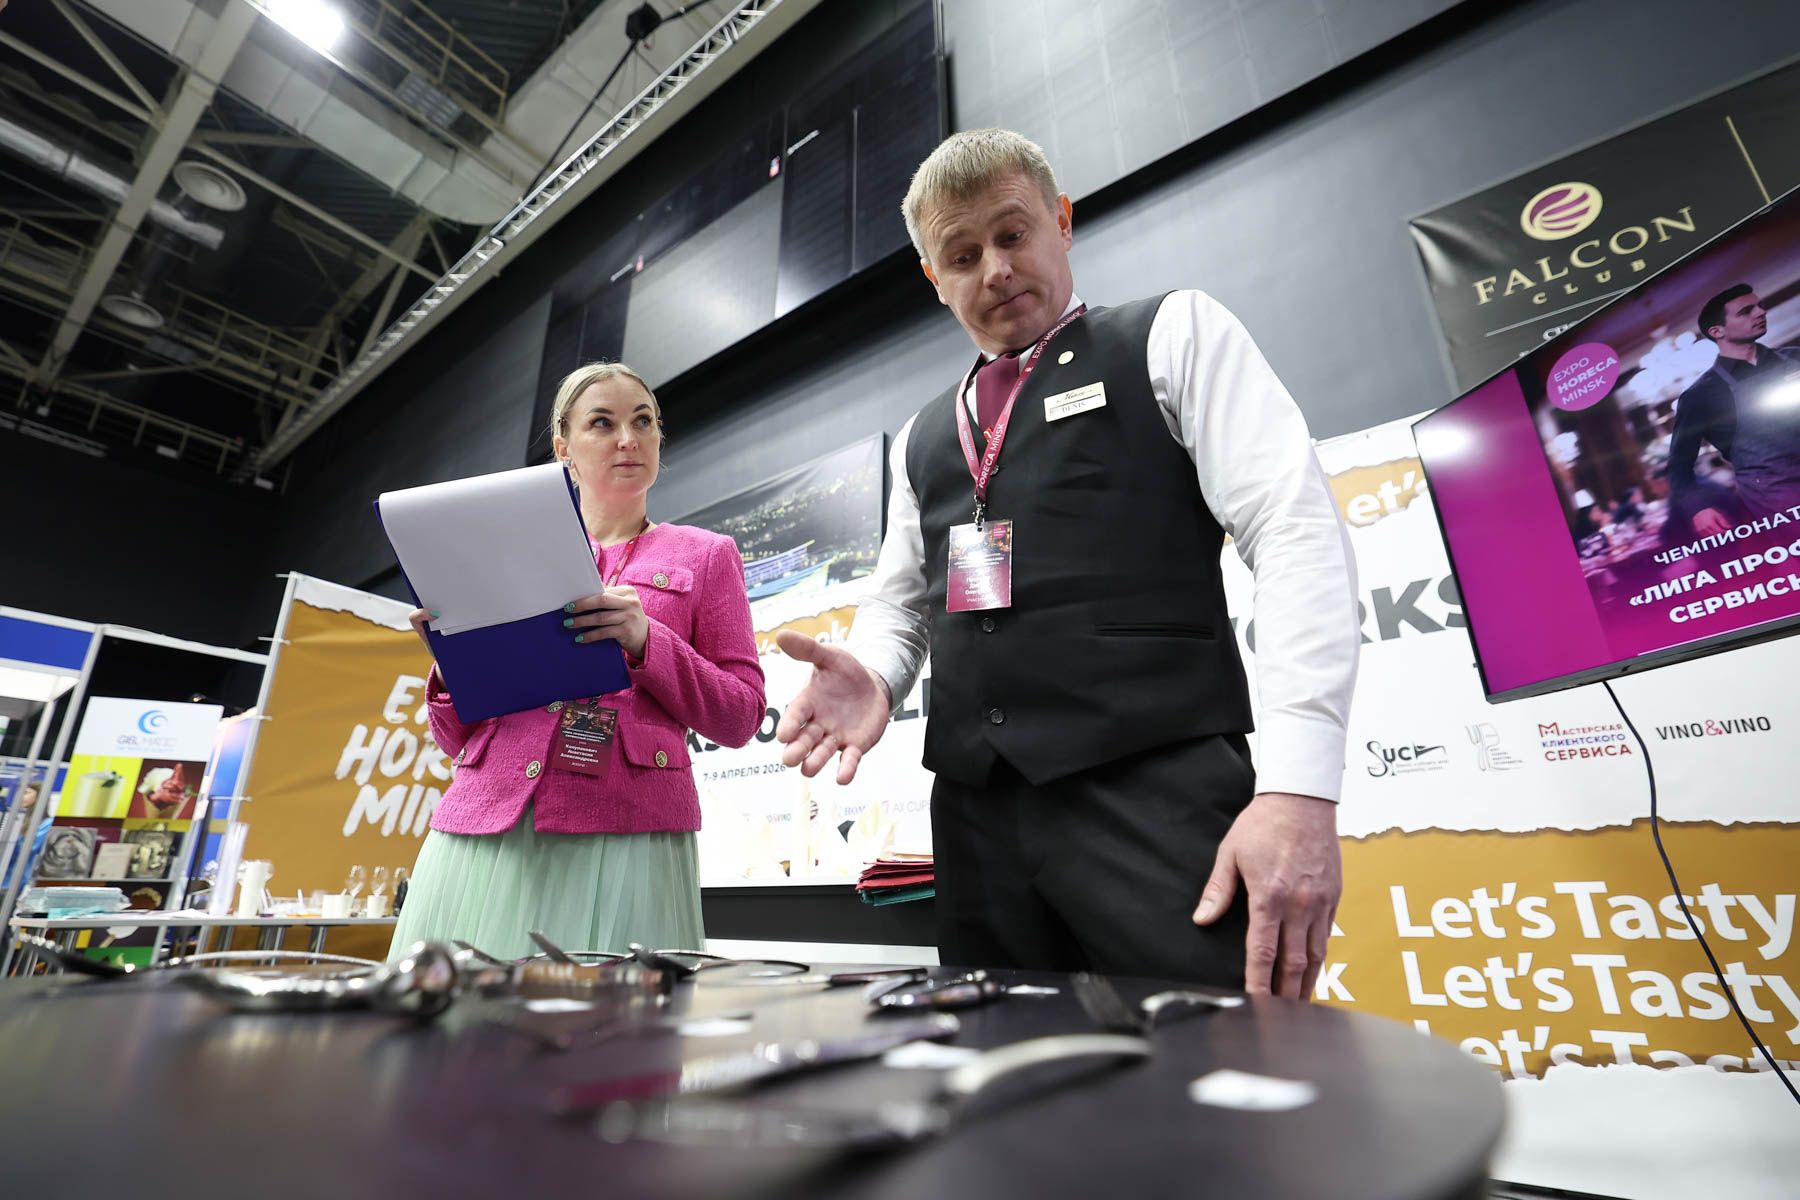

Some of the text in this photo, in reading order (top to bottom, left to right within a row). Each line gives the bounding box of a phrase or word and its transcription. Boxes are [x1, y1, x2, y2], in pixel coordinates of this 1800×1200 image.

[1472, 205, 1697, 305] FALCON
[1532, 259, 1646, 304] CLUB
[1554, 357, 1590, 382] EXPO
[1557, 357, 1617, 393] HORECA
[1561, 375, 1607, 405] MINSK
[990, 423, 1005, 450] MINSK
[1346, 470, 1428, 527] et'
[1653, 505, 1800, 564] ЧЕМПИОНАТ
[1629, 570, 1717, 606] «ЛИГА
[1542, 733, 1626, 748] КЛИЕНТСКОГО
[1656, 716, 1771, 740] VINO&VINO
[334, 723, 456, 786] HOR
[1544, 744, 1632, 762] СЕРВИСА
[720, 766, 760, 780] АПРЕЛЯ
[763, 763, 786, 775] 2026
[1390, 880, 1796, 960] Let's Tasty
[1401, 951, 1574, 1013] Let's
[1571, 953, 1800, 1045] Tasty
